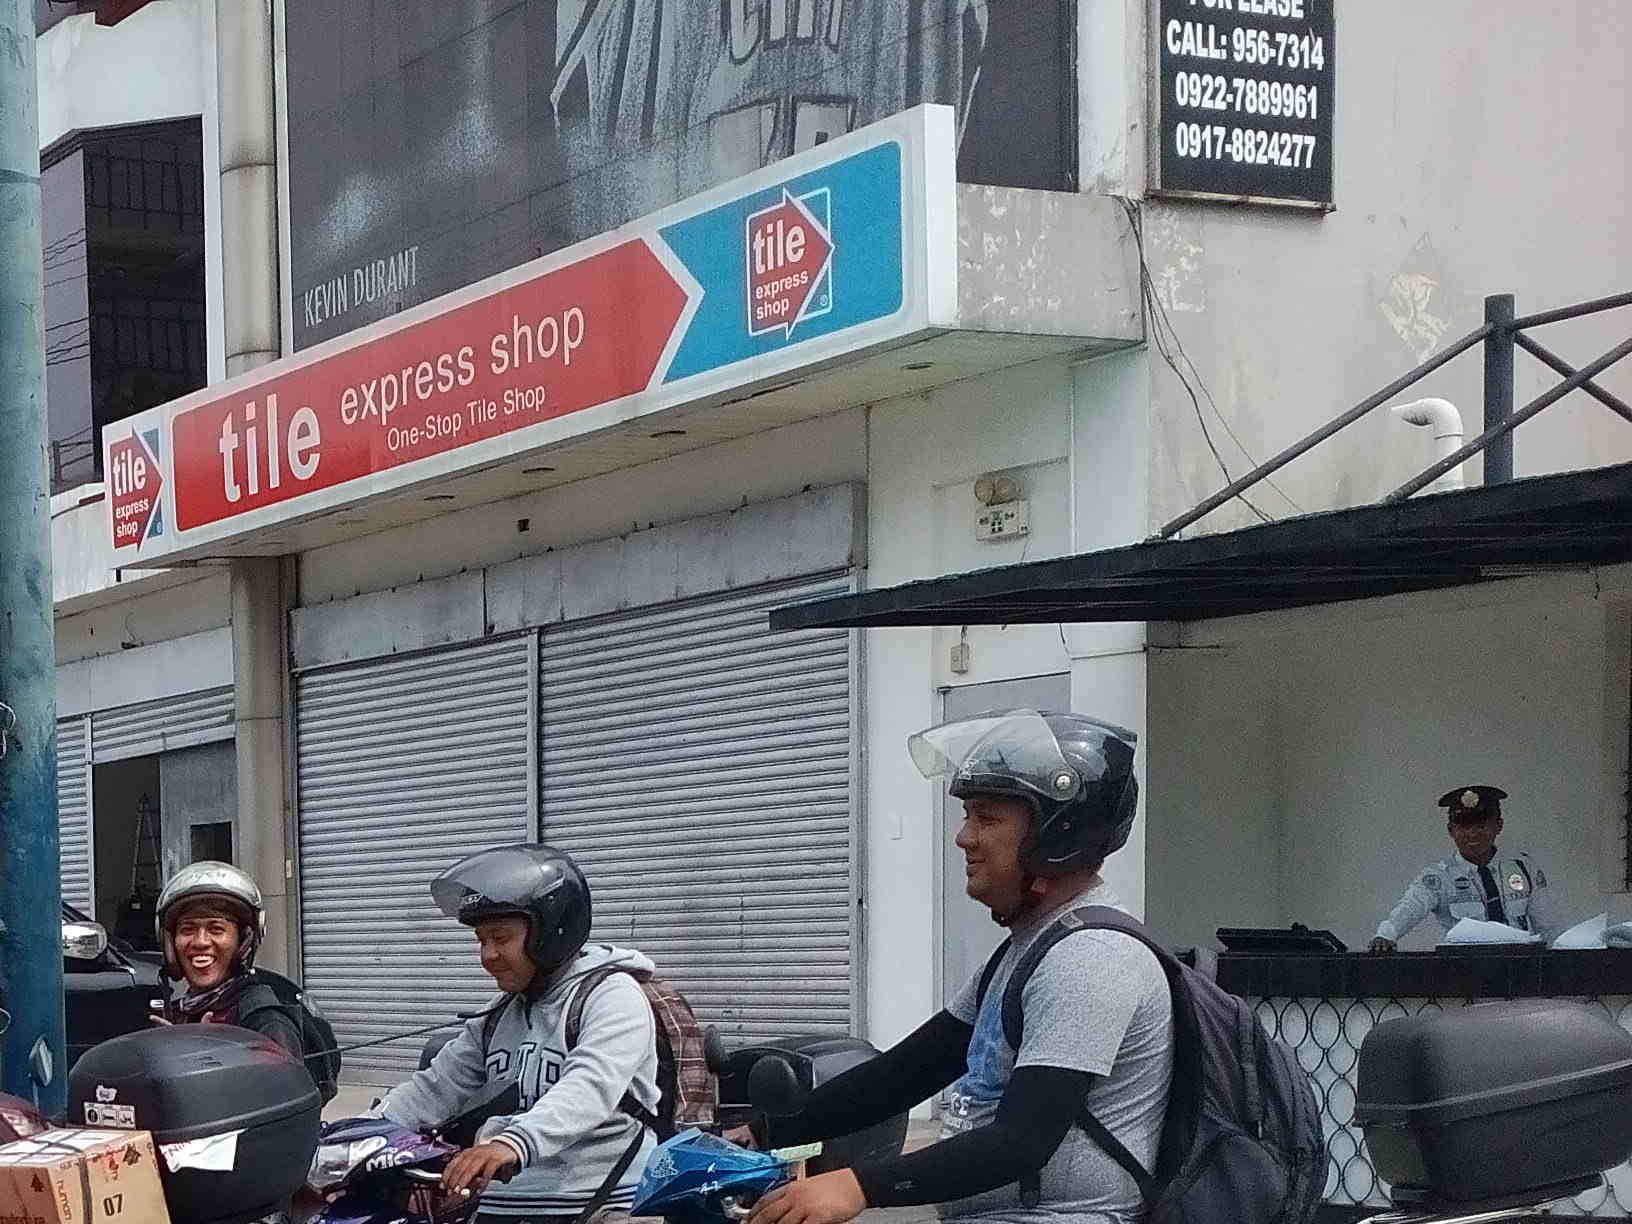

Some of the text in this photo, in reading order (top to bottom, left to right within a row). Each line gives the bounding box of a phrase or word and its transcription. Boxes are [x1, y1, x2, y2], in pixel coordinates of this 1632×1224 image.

[1167, 19, 1325, 71] CALL: 956-7314
[1175, 71, 1317, 120] 0922-7889961
[1175, 121, 1316, 168] 0917-8824277
[753, 219, 806, 274] tile
[304, 245, 419, 328] KEVIN DURANT
[756, 270, 809, 299] express
[756, 297, 790, 320] shop
[220, 306, 585, 503] tile express shop
[387, 385, 546, 452] One-Stop Tile Shop
[113, 448, 147, 497] tile
[115, 498, 149, 521] express
[116, 520, 138, 538] shop
[103, 1193, 125, 1218] 07
